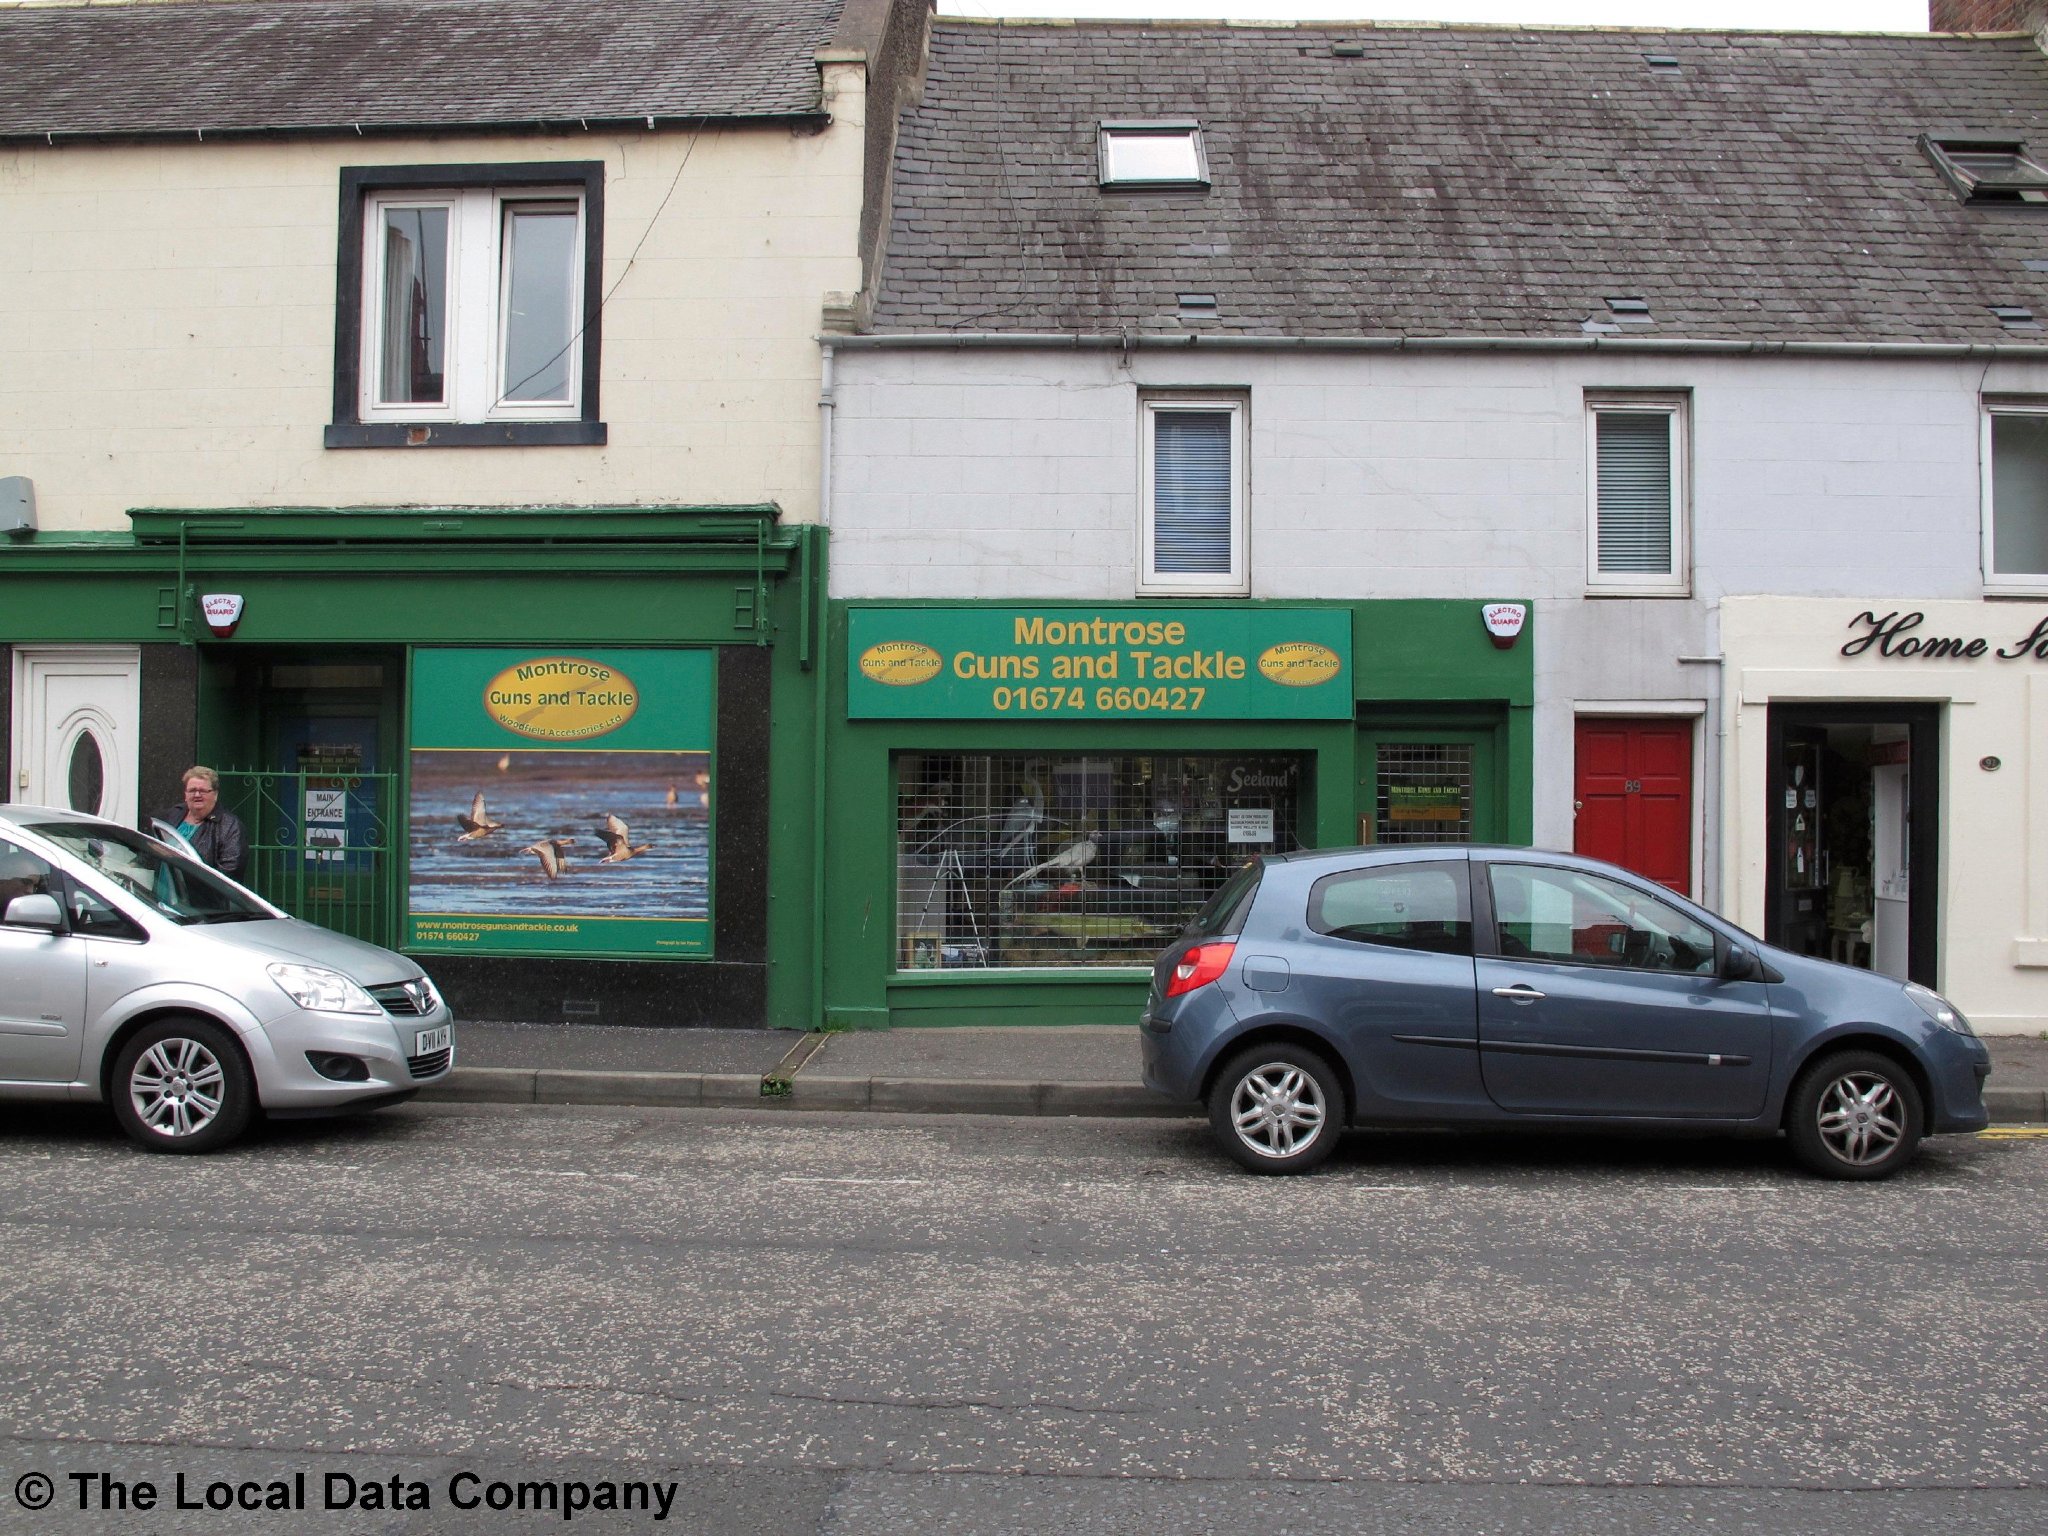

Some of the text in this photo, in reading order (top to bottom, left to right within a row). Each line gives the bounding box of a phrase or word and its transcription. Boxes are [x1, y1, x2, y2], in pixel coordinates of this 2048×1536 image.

[205, 599, 236, 608] ELECTRO
[1489, 607, 1521, 618] ELECTRO
[1014, 616, 1186, 645] Montrose
[1841, 611, 1988, 658] Home
[877, 643, 928, 655] Montrose
[1275, 644, 1326, 656] Montrose
[862, 659, 941, 667] Guns and Tackle
[953, 651, 1040, 679] Guns
[1052, 650, 1118, 679] and
[1130, 650, 1246, 680] Tackle
[1260, 659, 1339, 668] Guns and Tackle
[517, 660, 611, 681] Montrose
[490, 691, 634, 706] Guns and Tackle
[993, 686, 1207, 711] 01674 660427
[500, 713, 622, 737] Woodfield Accessories Ltd
[1227, 767, 1288, 792] Seeland
[1625, 780, 1641, 793] 89
[316, 793, 334, 802] MAIN
[307, 808, 343, 818] ENTRANCE
[416, 921, 578, 932] www.montrosegunsandtackle.co.uk
[416, 932, 480, 941] 01674 660427
